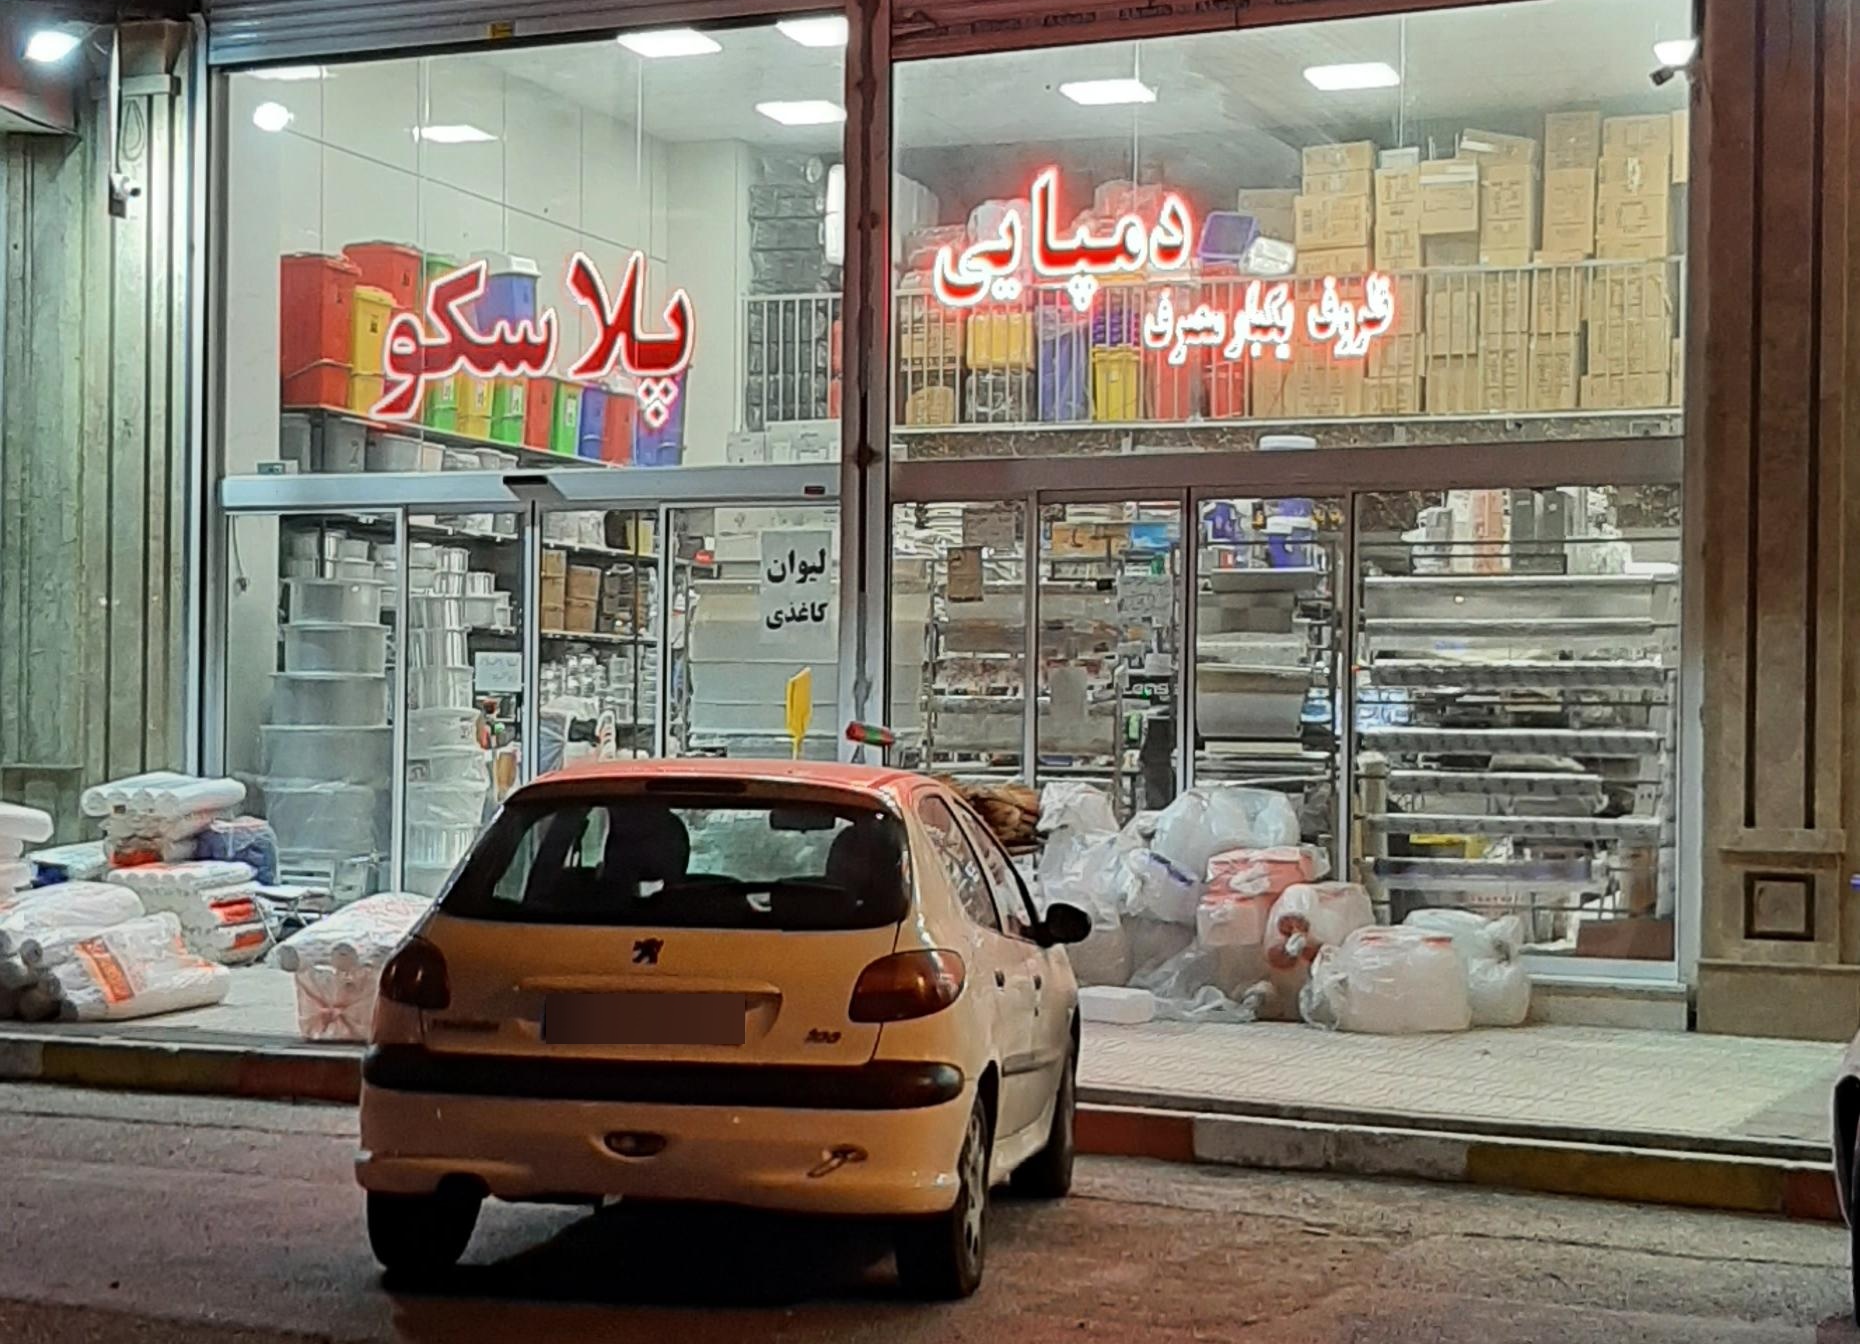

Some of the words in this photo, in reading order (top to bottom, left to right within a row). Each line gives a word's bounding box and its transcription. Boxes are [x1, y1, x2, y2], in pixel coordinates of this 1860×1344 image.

[934, 164, 1192, 312] دمپایی
[368, 250, 695, 428] پلاسکو
[1144, 288, 1225, 365] مصرف
[1223, 279, 1294, 360] یکبار
[1307, 271, 1395, 358] ظروف
[765, 548, 826, 584] لیوان
[765, 601, 829, 631] کاغذی
